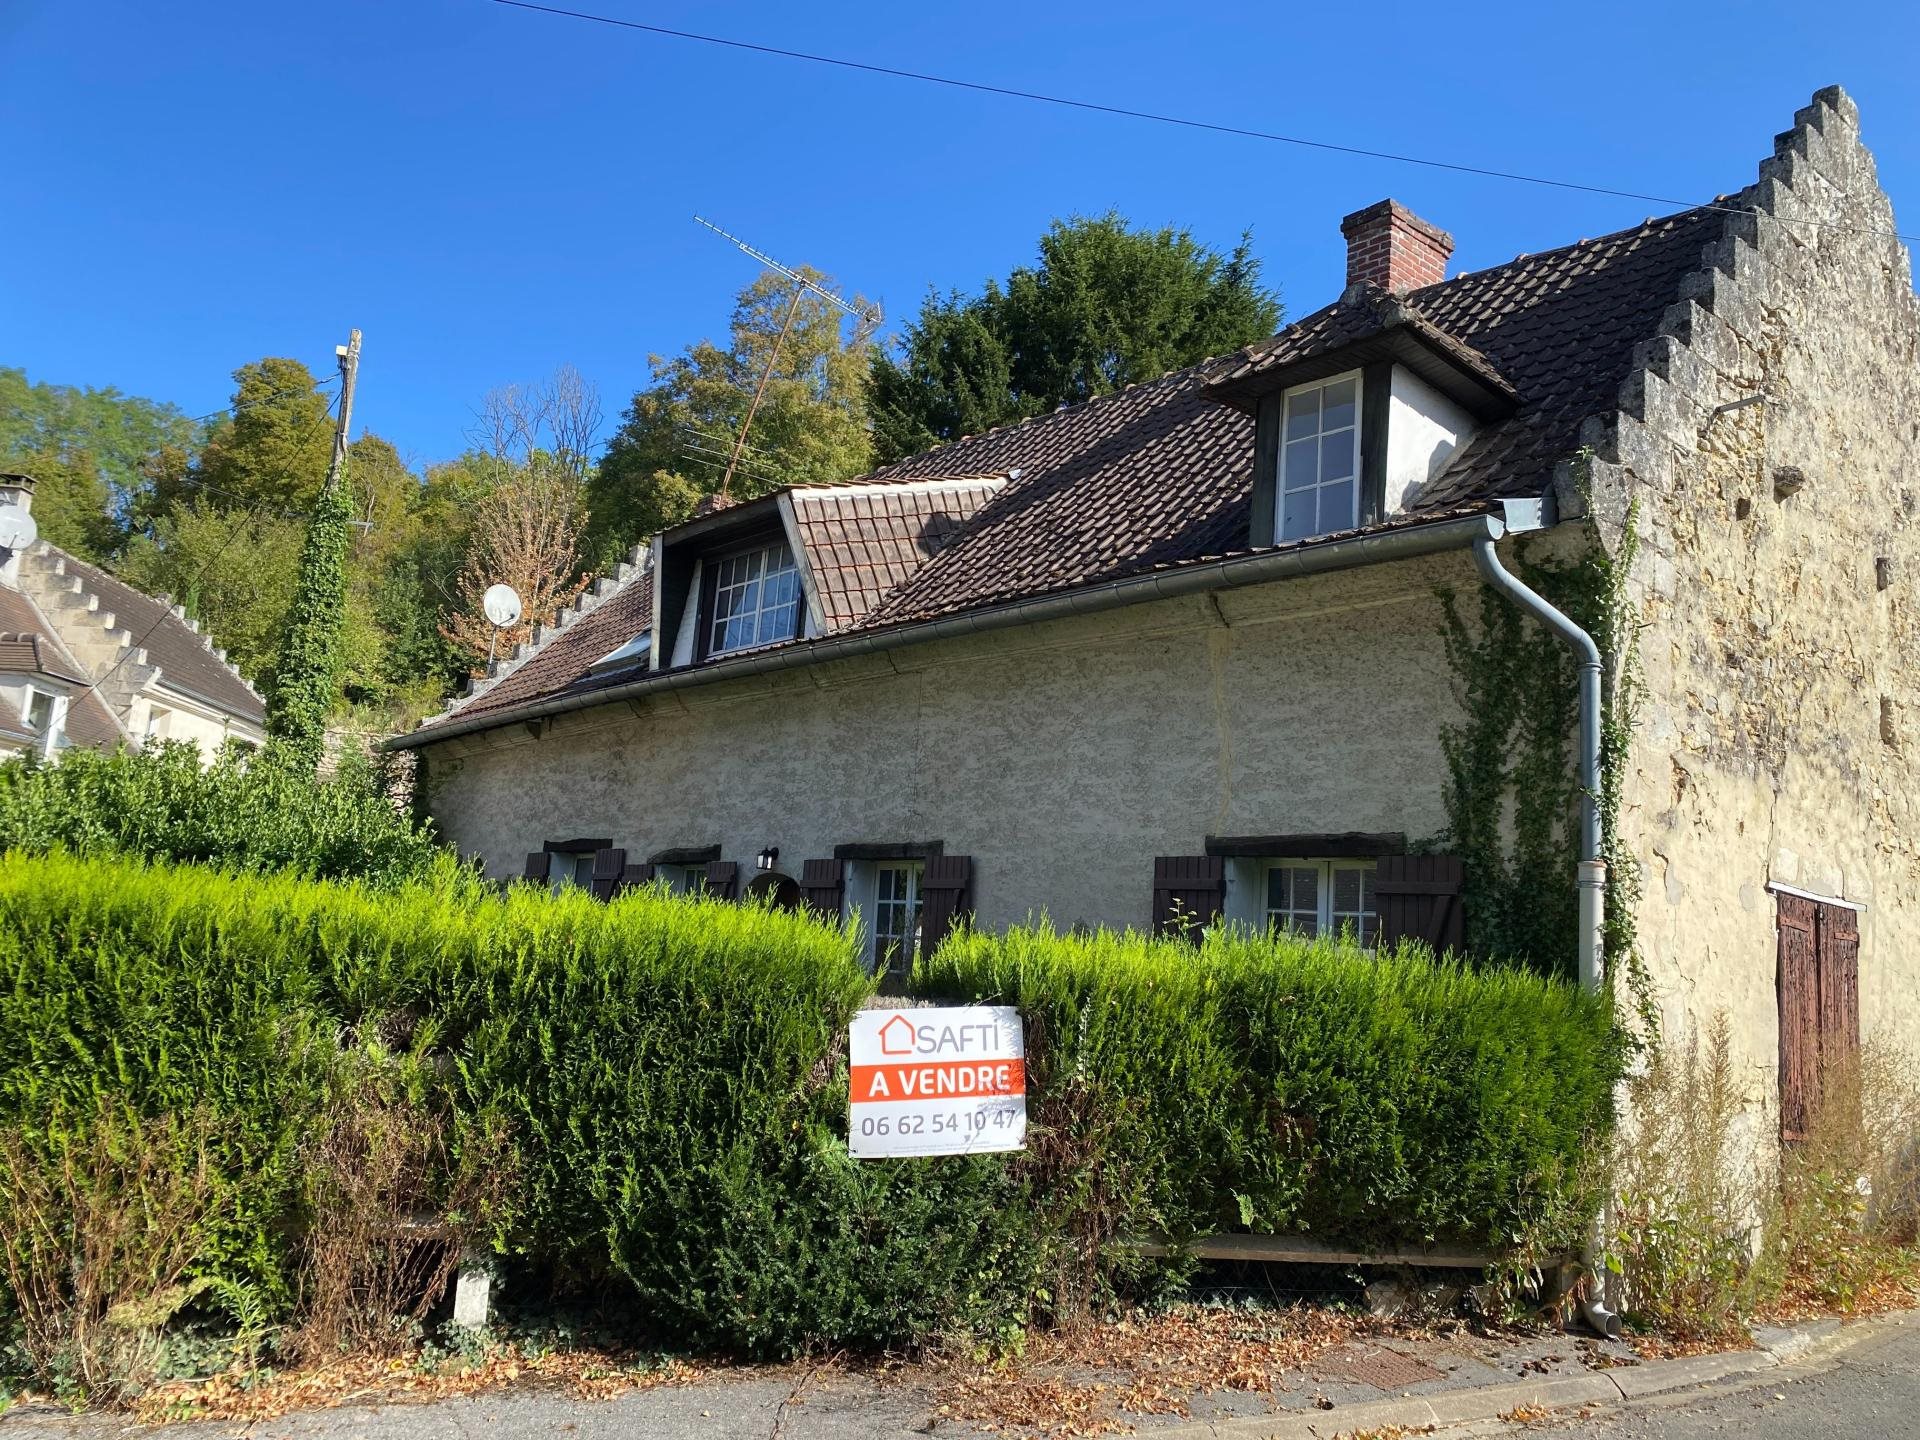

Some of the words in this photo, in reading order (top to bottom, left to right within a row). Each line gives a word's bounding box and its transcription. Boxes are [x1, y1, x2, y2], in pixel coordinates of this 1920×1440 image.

[868, 1071, 890, 1097] A
[898, 1066, 1011, 1096] VENDRE
[861, 1116, 890, 1136] 06
[897, 1115, 924, 1135] 62
[932, 1113, 958, 1133] 54
[964, 1111, 986, 1131] 10
[993, 1109, 1016, 1129] 47
